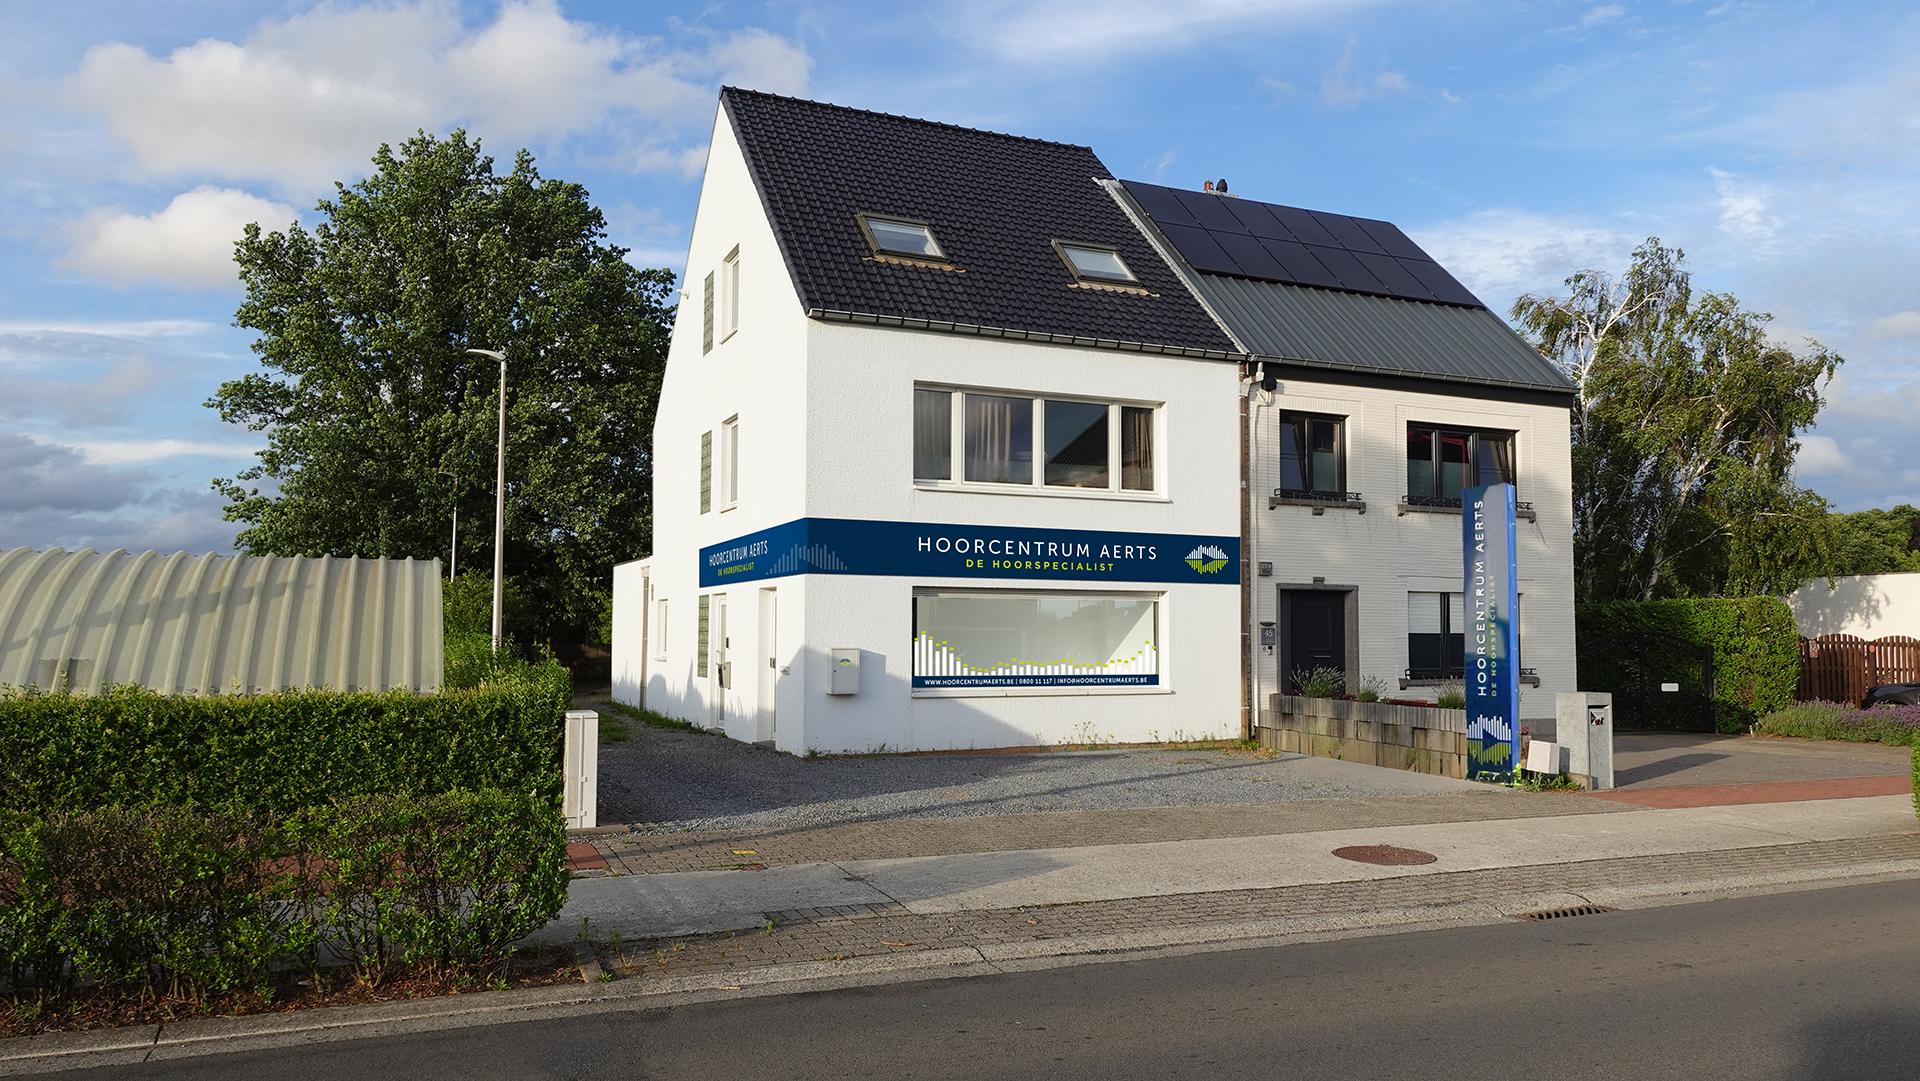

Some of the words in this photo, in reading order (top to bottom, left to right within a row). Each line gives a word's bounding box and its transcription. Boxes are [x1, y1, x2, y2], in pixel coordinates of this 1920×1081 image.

[1474, 500, 1484, 552] AERTS
[709, 546, 748, 566] HOORCENTRUM
[749, 540, 768, 556] AERTS
[918, 537, 1090, 557] HOORCENTRUM
[1099, 544, 1157, 560] AERTS
[966, 559, 984, 568] DE
[992, 560, 1114, 572] HOORSPECIALIST
[1475, 561, 1487, 696] HOORCENTRUM
